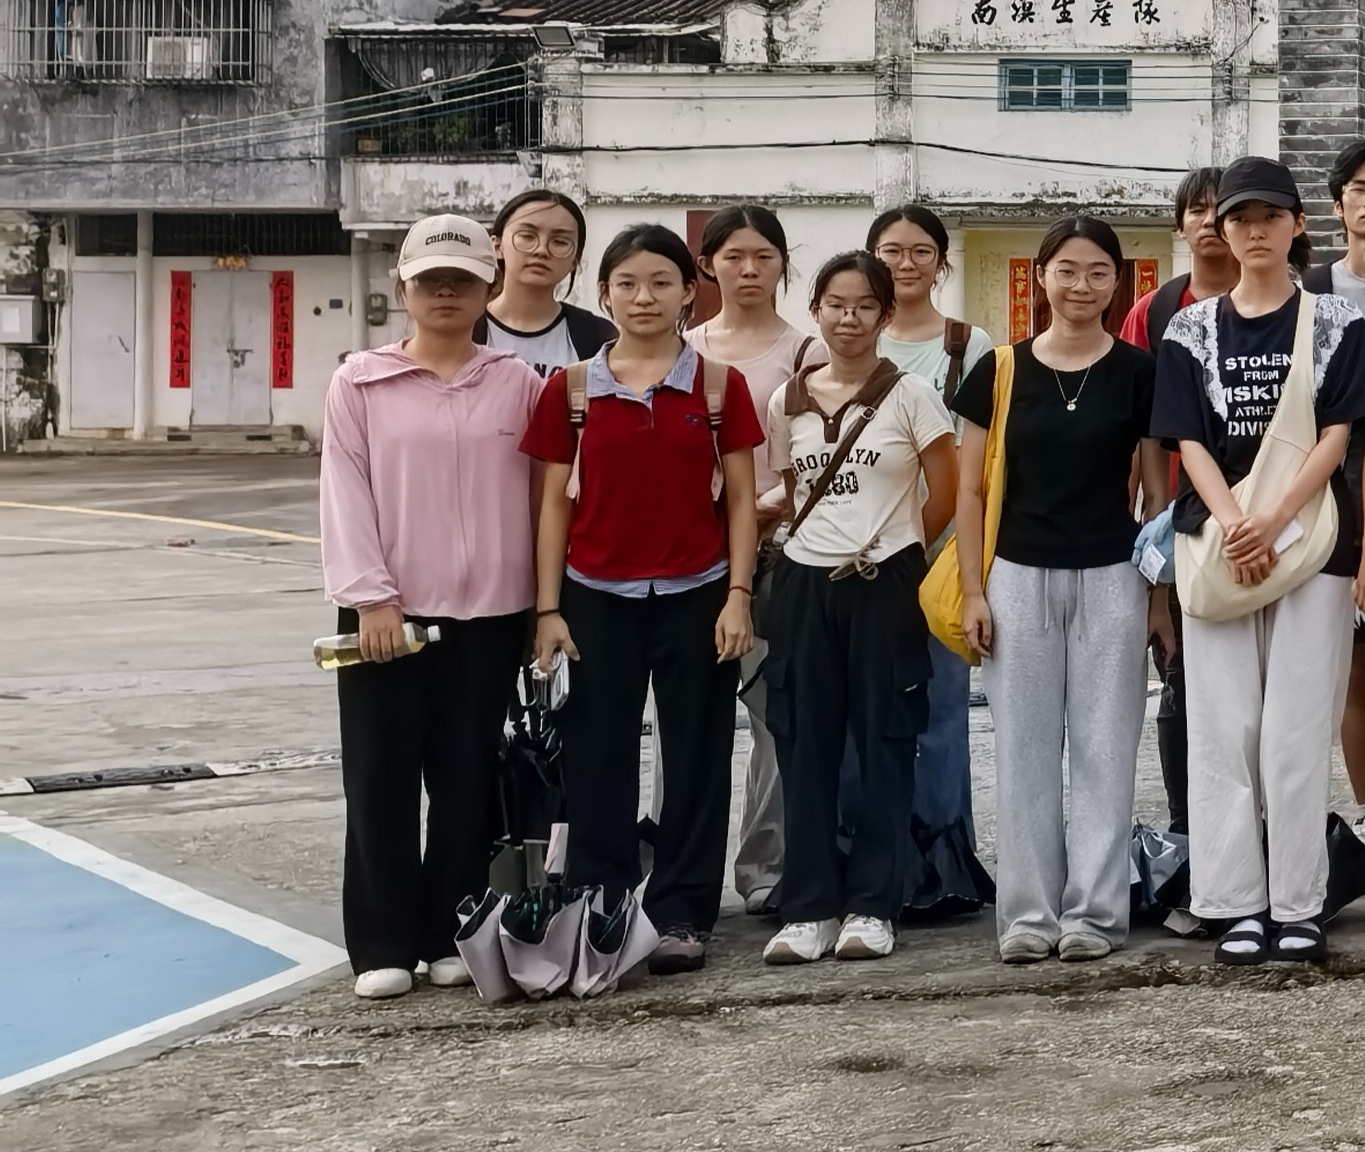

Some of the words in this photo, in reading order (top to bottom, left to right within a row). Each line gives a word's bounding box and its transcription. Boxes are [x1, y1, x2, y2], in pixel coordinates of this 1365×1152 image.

[425, 232, 471, 246] COLORADO
[1225, 353, 1293, 371] STOLEN
[1243, 370, 1279, 382] FROM
[791, 449, 881, 478] ROOLYN
